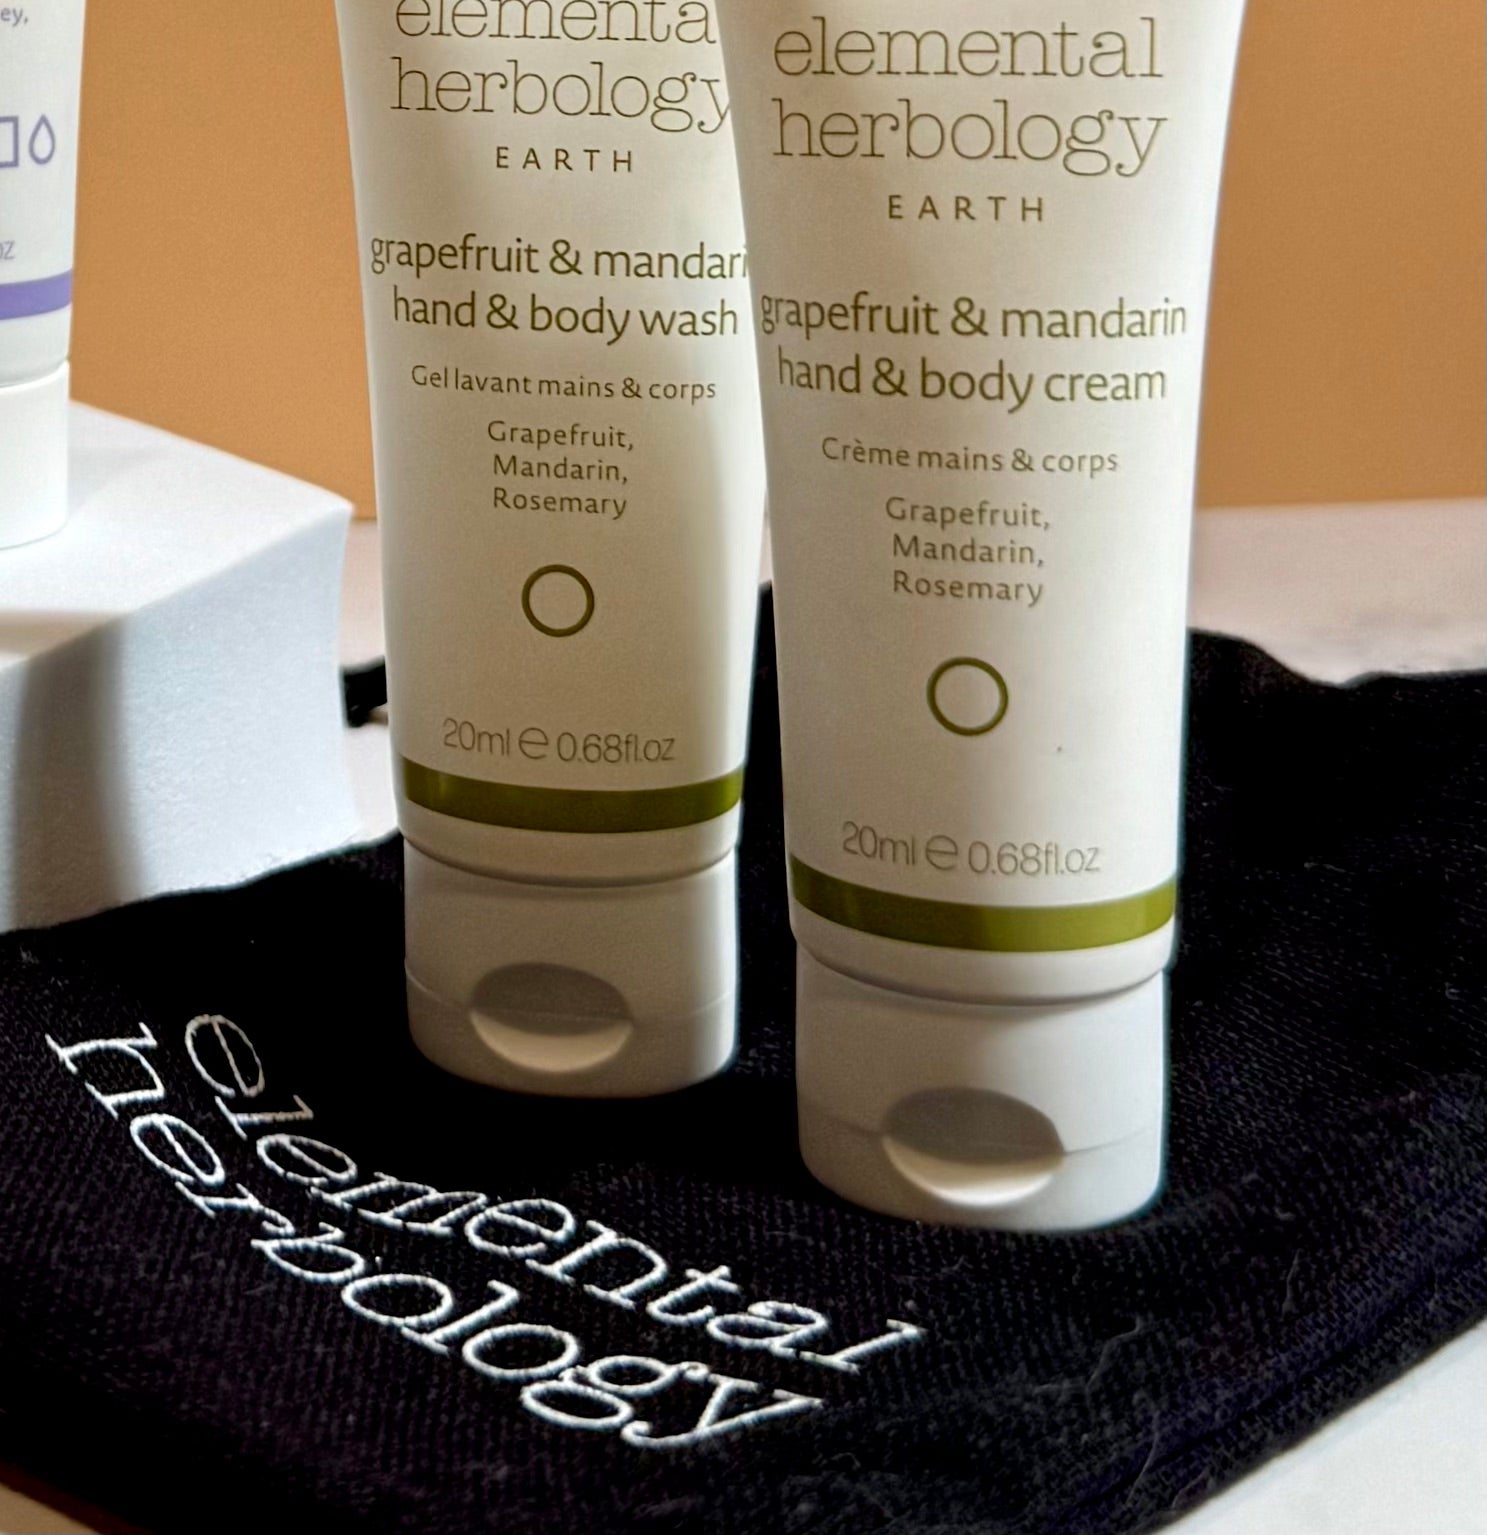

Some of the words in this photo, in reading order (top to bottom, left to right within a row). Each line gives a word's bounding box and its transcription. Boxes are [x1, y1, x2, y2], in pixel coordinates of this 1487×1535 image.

[774, 16, 1163, 78] elemental
[390, 56, 729, 134] herbology
[771, 98, 1168, 177] herbology
[497, 146, 631, 172] EARTH
[889, 195, 1043, 222] EARTH
[371, 233, 539, 279] grapefruit
[549, 239, 583, 275] &
[595, 242, 747, 279] mandari
[394, 285, 475, 328] hand
[487, 294, 519, 330] &
[531, 293, 630, 346] body
[639, 299, 737, 336] wash
[761, 291, 939, 340] grapefruit
[951, 297, 989, 336] &
[1002, 297, 1186, 338] mandarin
[412, 365, 448, 388] Gel
[455, 368, 531, 394] lavant
[539, 376, 614, 397] mains
[622, 377, 642, 399] &
[649, 383, 715, 405] corps
[778, 345, 861, 394] hand
[872, 357, 908, 397] &
[921, 357, 1034, 414] body
[1045, 371, 1165, 402] cream
[488, 421, 633, 451] Grapefruit,
[494, 454, 627, 485] Mandarin,
[822, 437, 910, 467] Crème
[918, 447, 1004, 471] mains
[1011, 448, 1034, 472] &
[1042, 454, 1118, 479] corps
[494, 487, 627, 520] Rosemary
[886, 497, 1050, 531] Grapefruit,
[893, 533, 1043, 568] Mandarin,
[894, 570, 1043, 608] Rosemary
[443, 717, 510, 756] 20ml
[843, 821, 917, 866] 20ml
[183, 1012, 928, 1373] elemental
[45, 1021, 823, 1449] herbology
